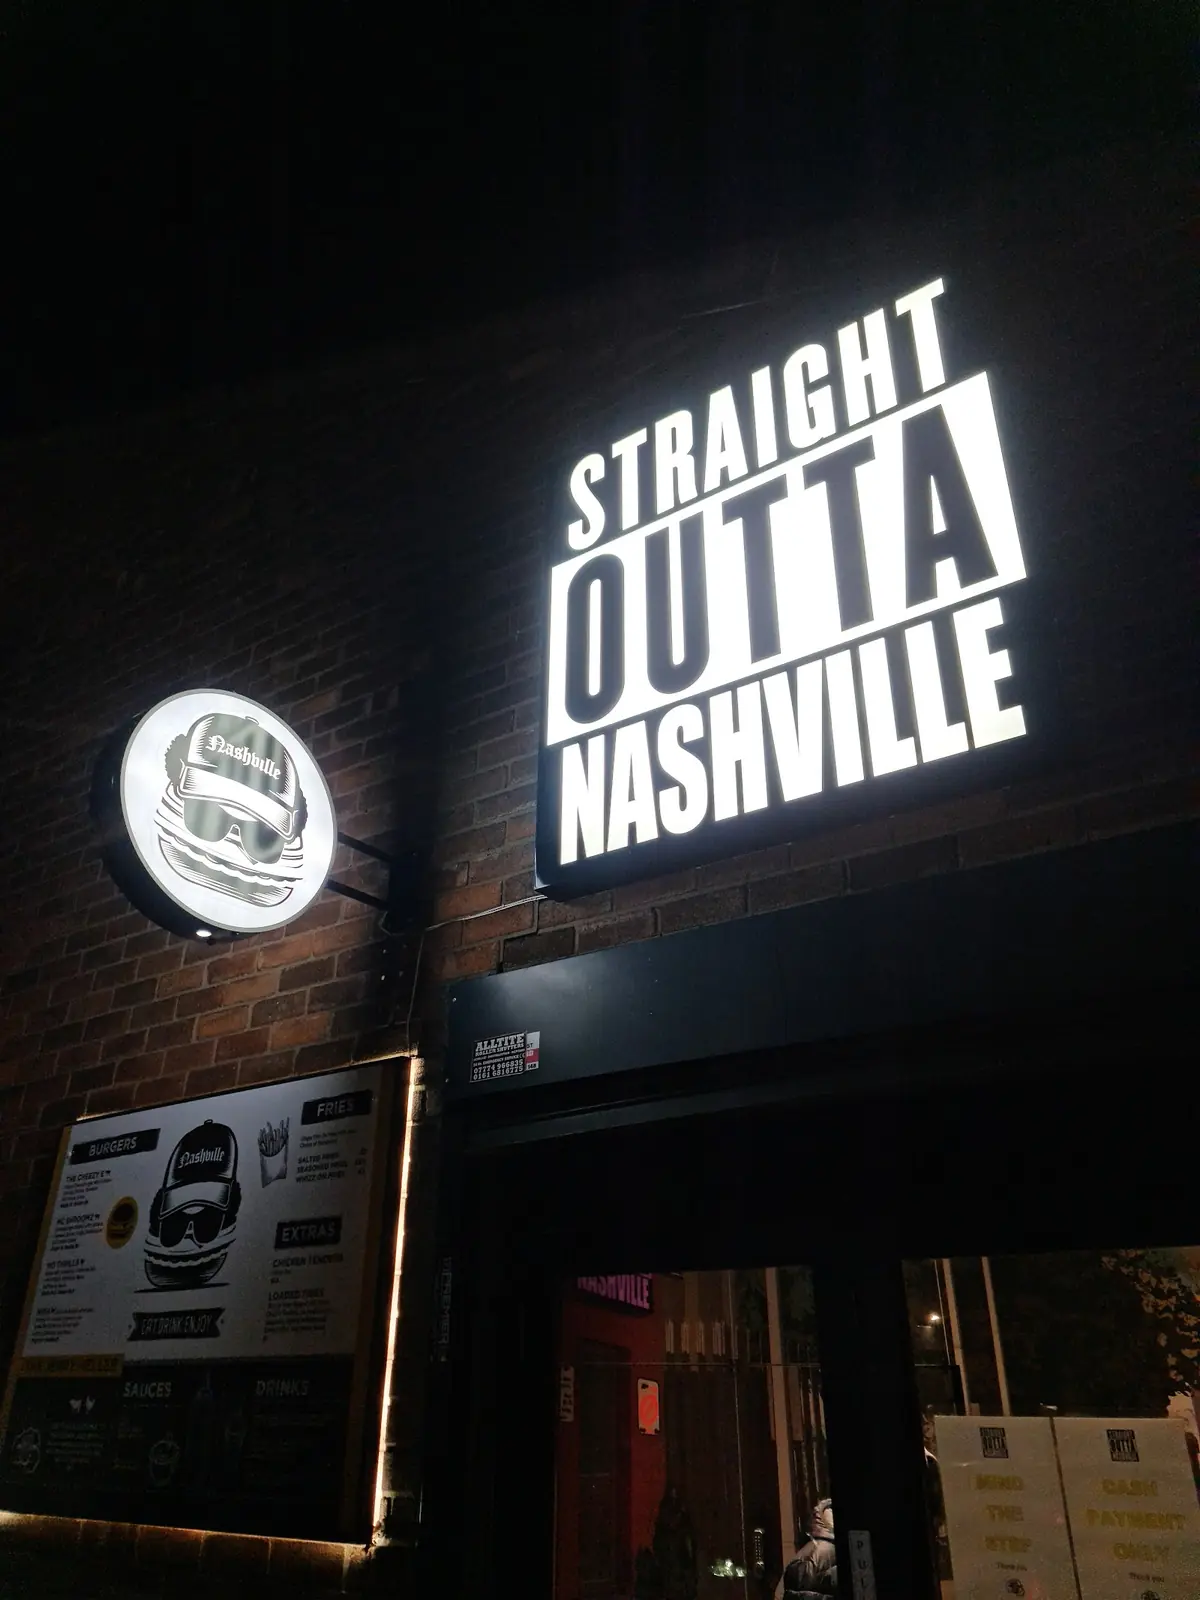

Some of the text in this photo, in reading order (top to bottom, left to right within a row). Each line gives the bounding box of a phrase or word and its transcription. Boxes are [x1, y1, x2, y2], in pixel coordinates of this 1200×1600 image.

[567, 277, 945, 550] STRAIGHT
[564, 404, 999, 725] OUTTA
[559, 597, 1027, 866] NASHVILLE
[205, 734, 281, 780] Nashville
[475, 1033, 525, 1052] ALLTITE
[497, 1043, 525, 1053] SHUTTERS
[473, 1064, 496, 1074] 07774
[473, 1071, 491, 1081] 0161
[316, 1098, 355, 1117] FRIES
[88, 1136, 138, 1157] BURGERS
[177, 1147, 225, 1169] Nashville
[281, 1221, 336, 1243] EXTRAS
[122, 1380, 173, 1399] SAUCES
[255, 1378, 310, 1397] DRINKS
[1101, 1478, 1158, 1497] CASH
[986, 1504, 1024, 1523] THE
[1085, 1508, 1187, 1531] PAYMENT
